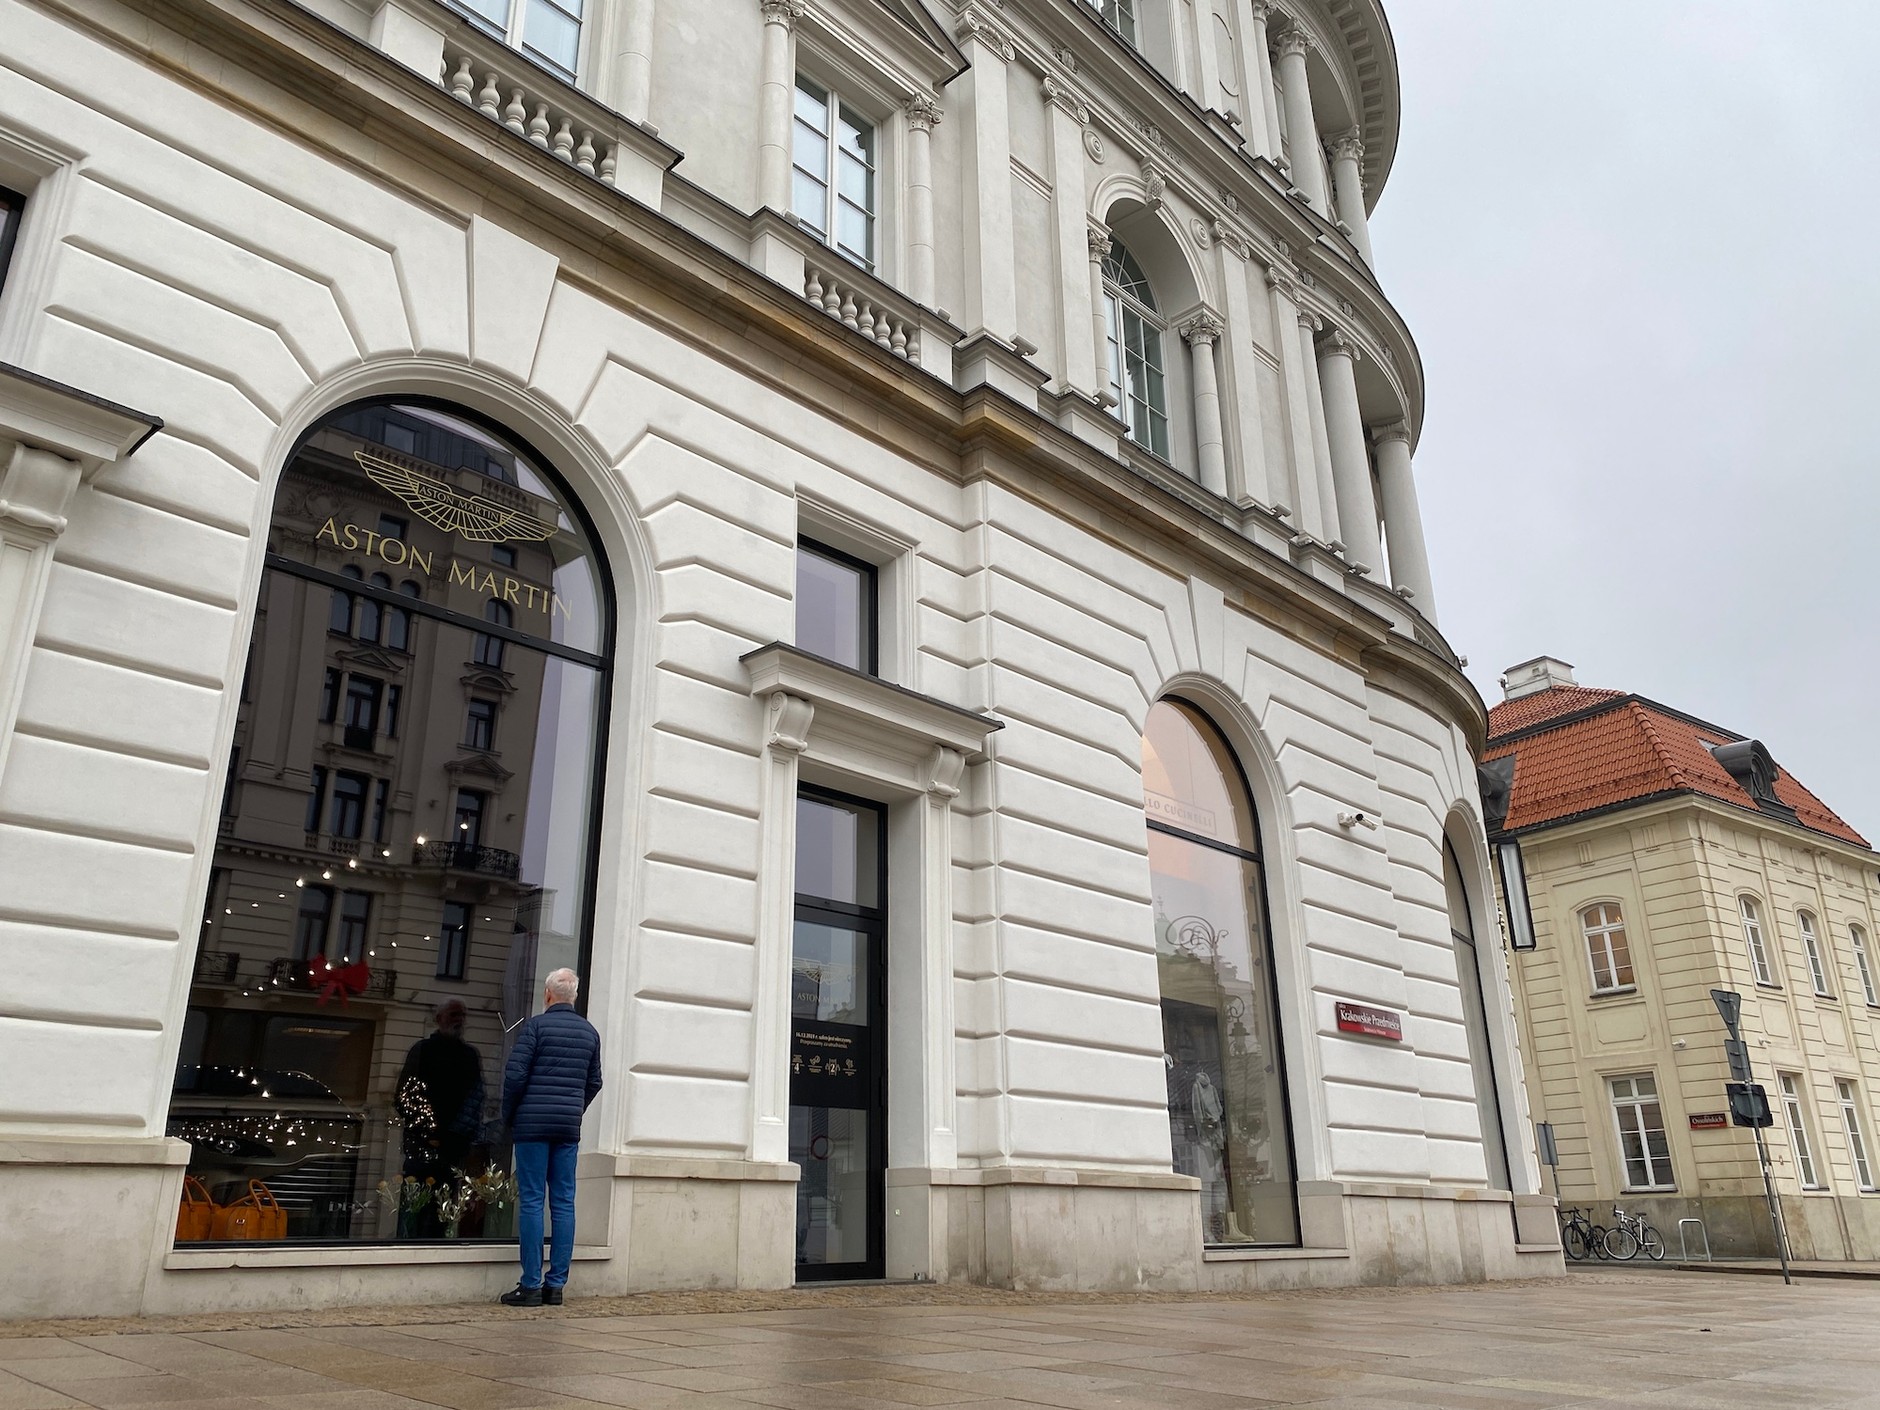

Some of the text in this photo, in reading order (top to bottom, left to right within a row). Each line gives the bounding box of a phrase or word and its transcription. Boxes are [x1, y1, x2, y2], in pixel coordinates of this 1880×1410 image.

[419, 486, 499, 521] ASTON MARTIN
[315, 517, 573, 621] ASTON MARTIN
[1164, 803, 1212, 827] CUCINELLI
[794, 1062, 799, 1072] 4
[830, 1063, 836, 1073] 2
